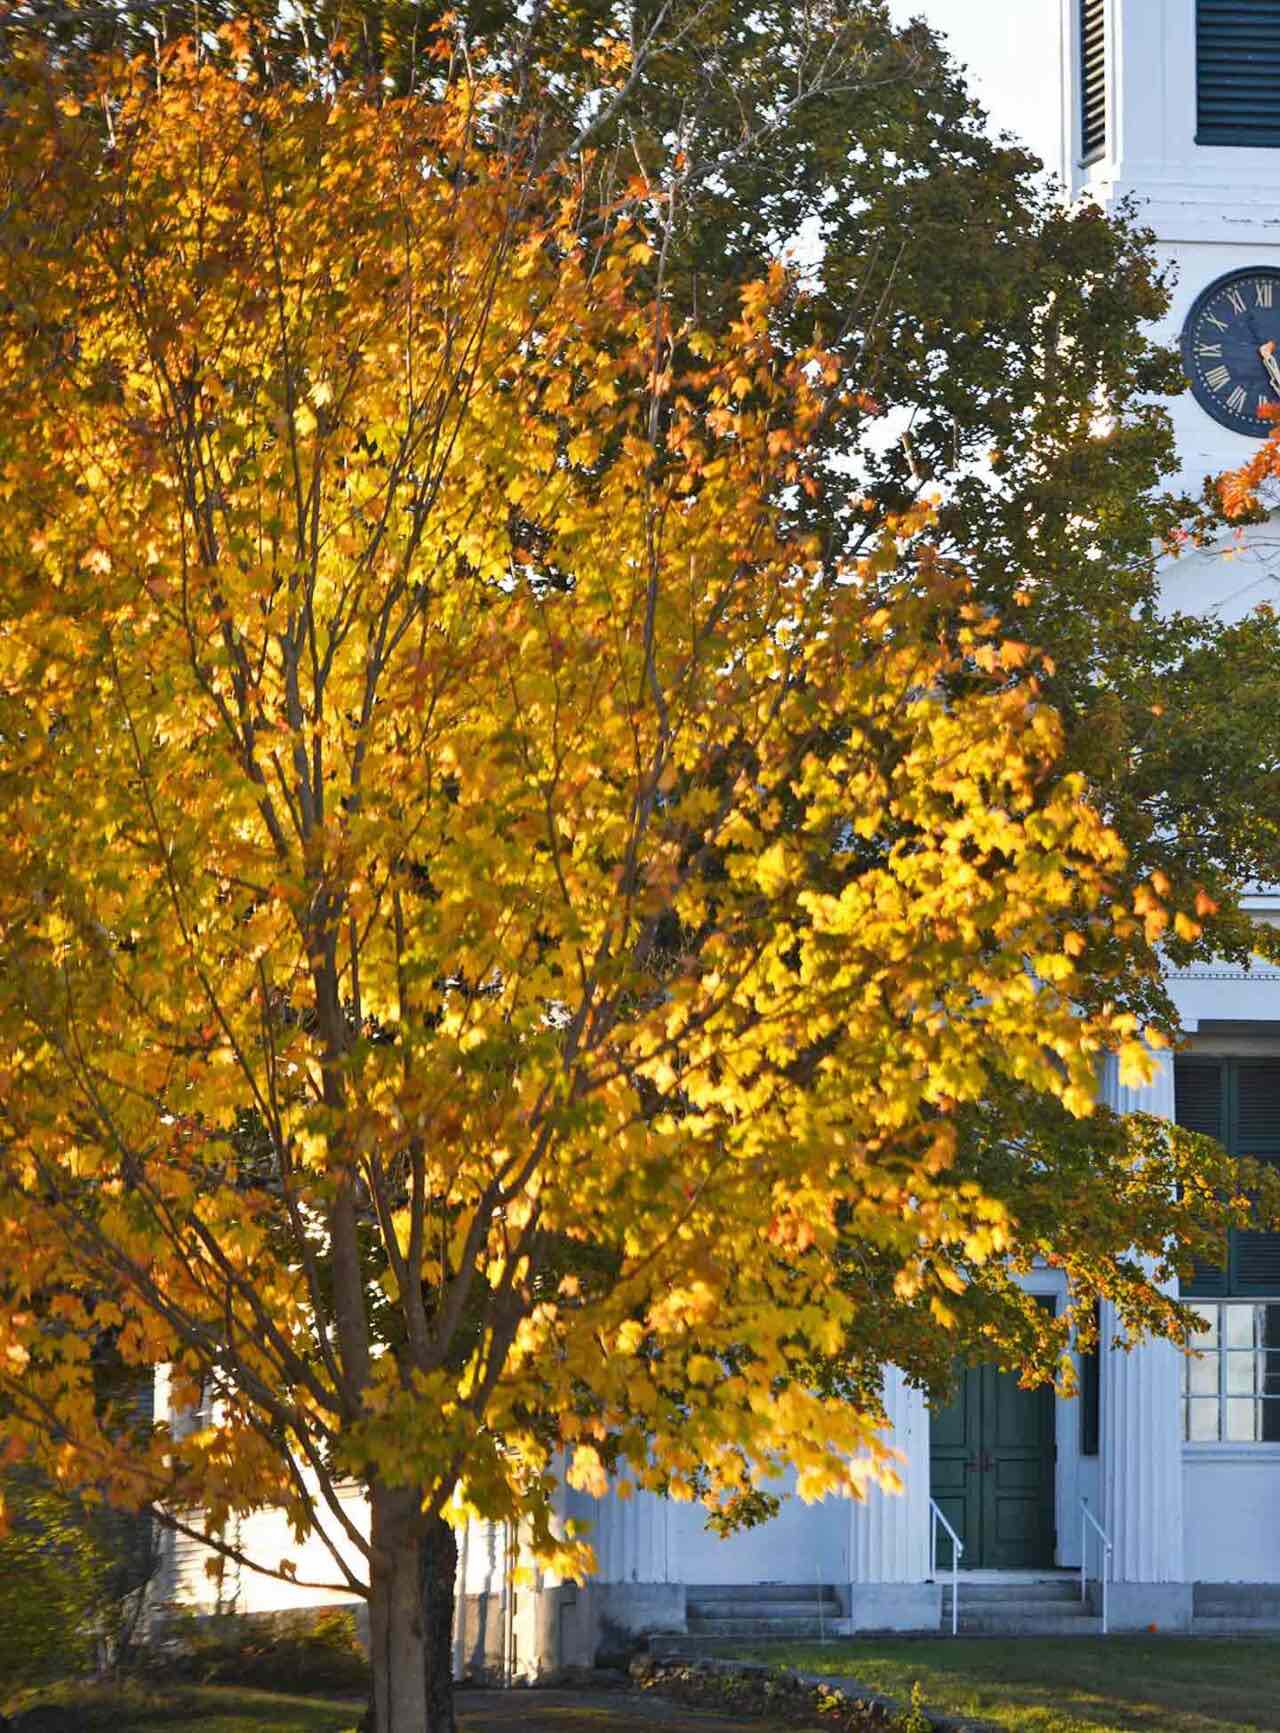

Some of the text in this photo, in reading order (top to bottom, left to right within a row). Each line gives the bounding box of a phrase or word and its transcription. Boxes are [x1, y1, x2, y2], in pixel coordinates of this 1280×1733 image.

[1226, 287, 1247, 315] XI
[1255, 283, 1272, 308] XII
[1206, 312, 1228, 332] X
[1199, 343, 1222, 357] IX
[1204, 365, 1231, 392] VIII
[1226, 384, 1247, 413] VII
